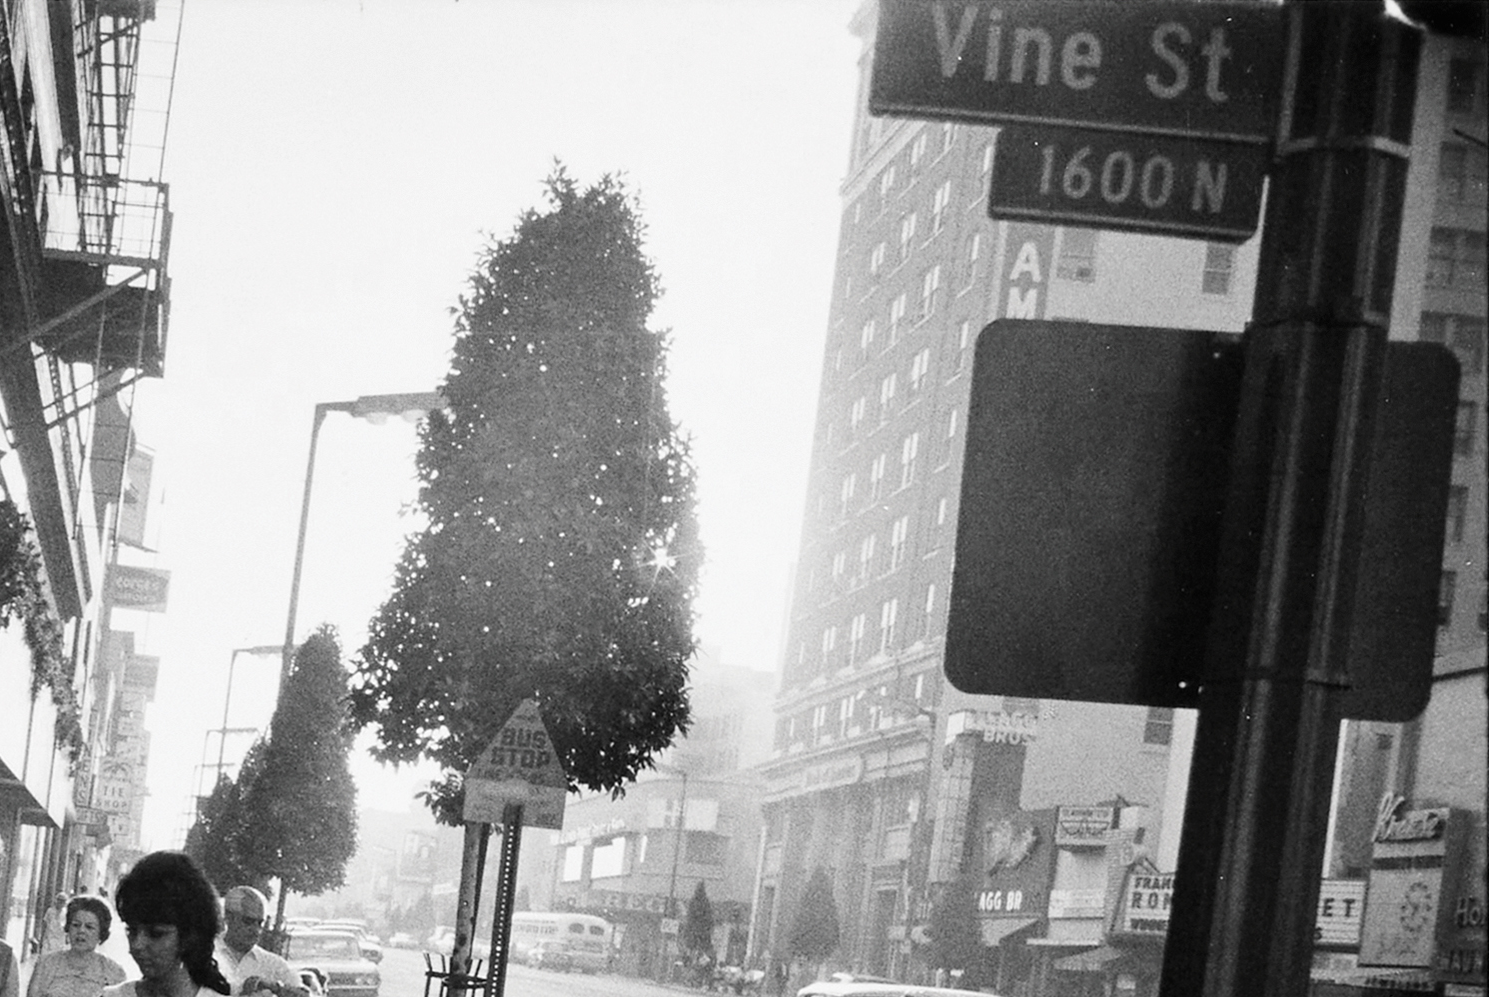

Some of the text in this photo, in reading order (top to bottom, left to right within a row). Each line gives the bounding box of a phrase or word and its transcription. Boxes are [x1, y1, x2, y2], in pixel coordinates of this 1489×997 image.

[929, 0, 1232, 101] Vine St
[1040, 145, 1227, 213] 1600 N
[491, 747, 551, 768] STOP
[501, 727, 547, 750] BUS
